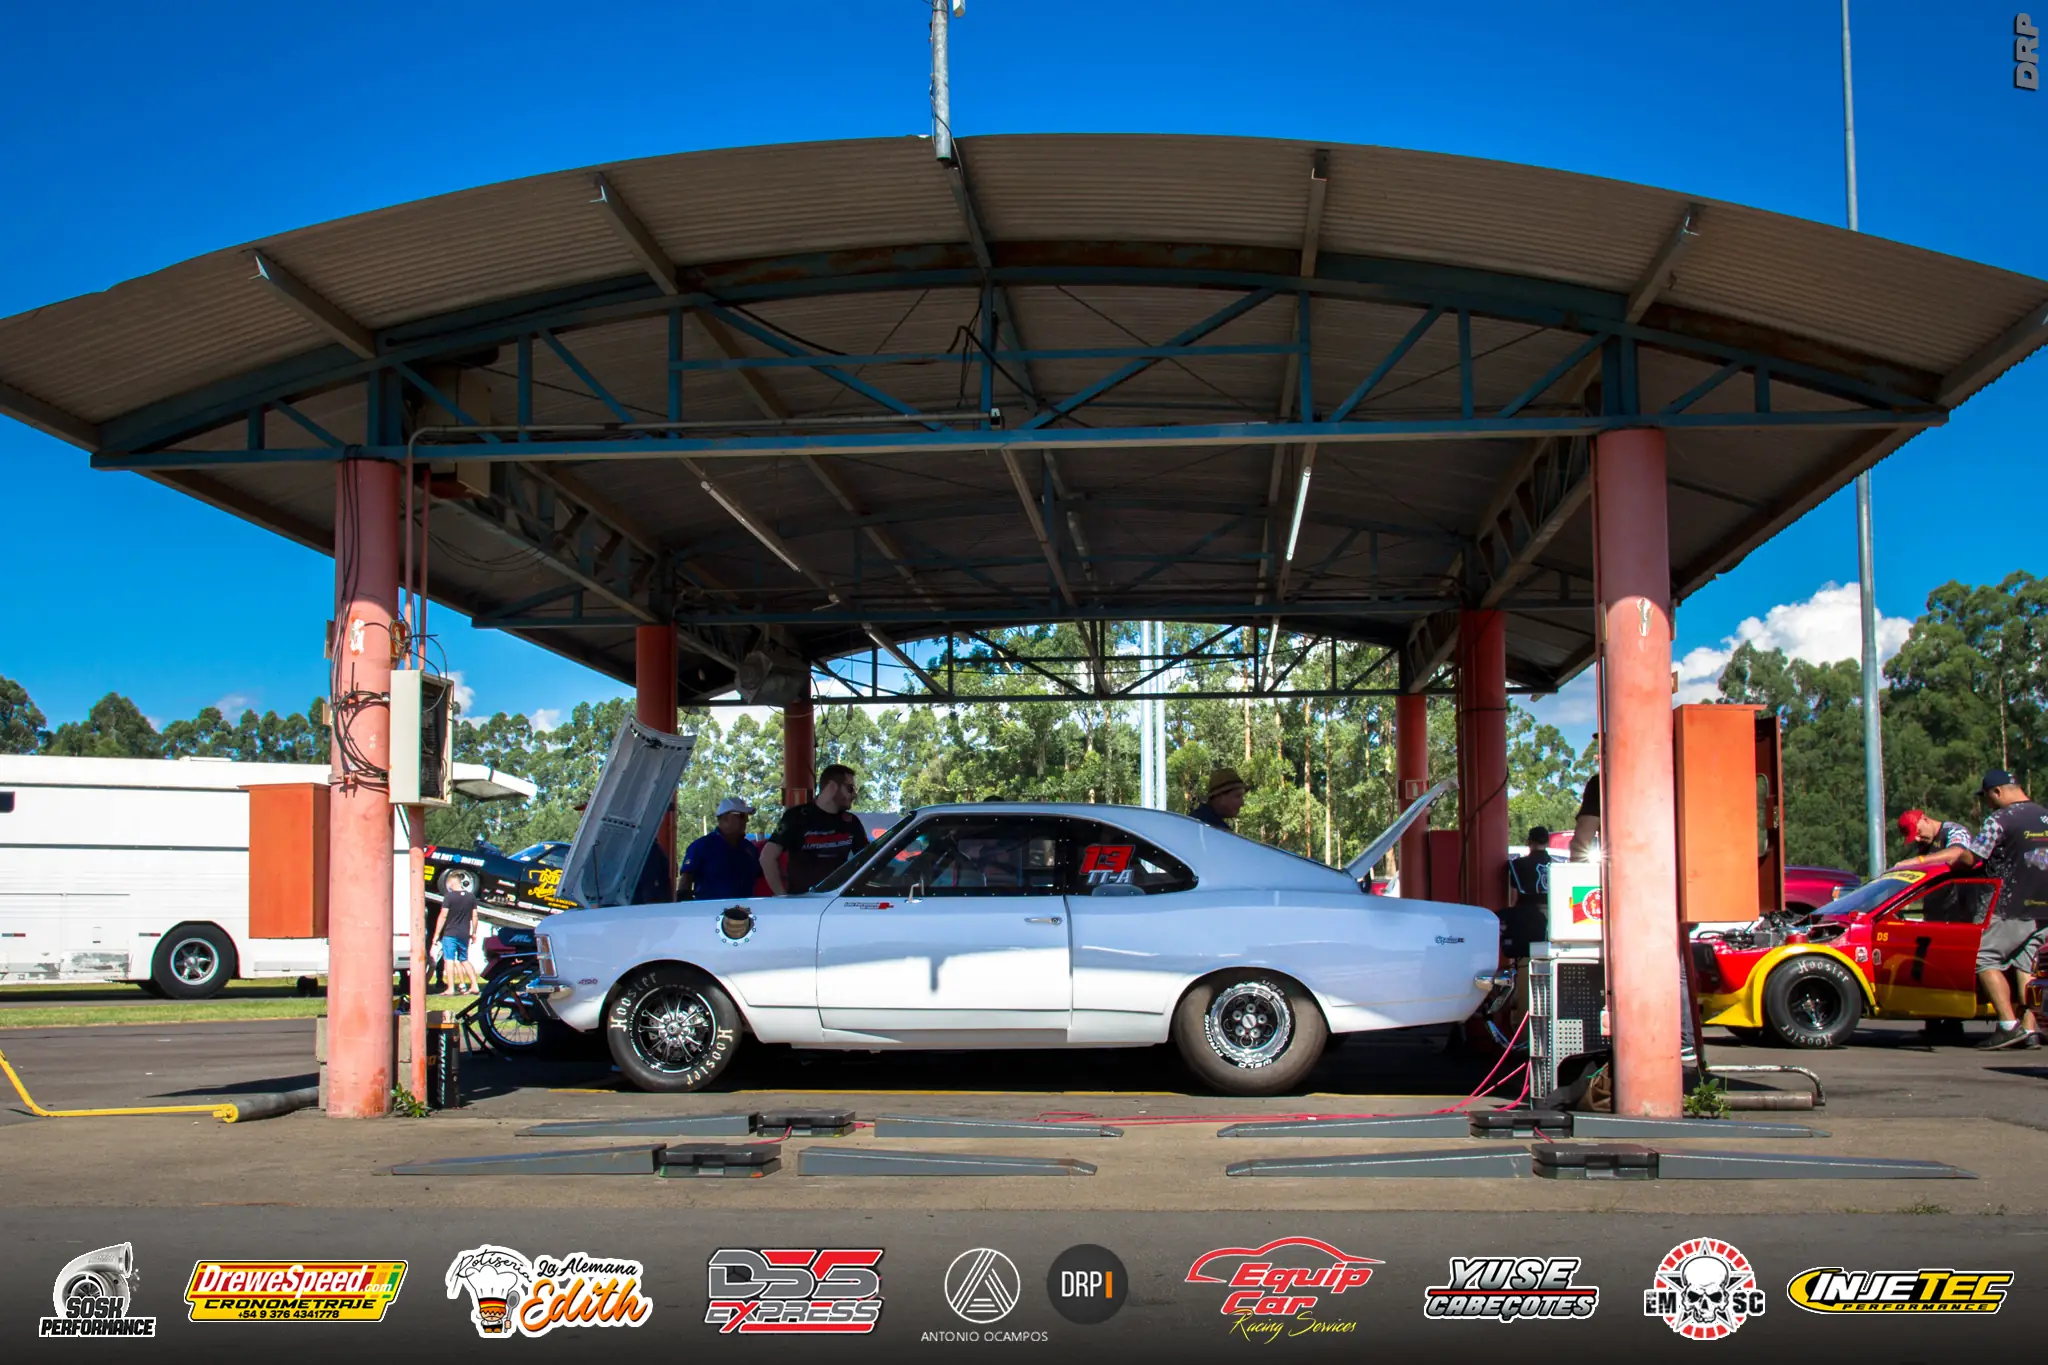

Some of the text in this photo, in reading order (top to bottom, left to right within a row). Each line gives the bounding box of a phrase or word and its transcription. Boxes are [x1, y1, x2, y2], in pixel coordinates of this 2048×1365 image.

[1080, 845, 1135, 875] 13
[1087, 869, 1133, 885] TT-A
[1876, 932, 1889, 942] DS
[1797, 959, 1849, 982] Hoosier
[610, 971, 658, 1032] Hoosier
[1204, 1014, 1224, 1057] RACING
[1781, 1024, 1833, 1048] Hoosier
[685, 1025, 734, 1086] Hoosier
[1238, 1058, 1272, 1069] WELD
